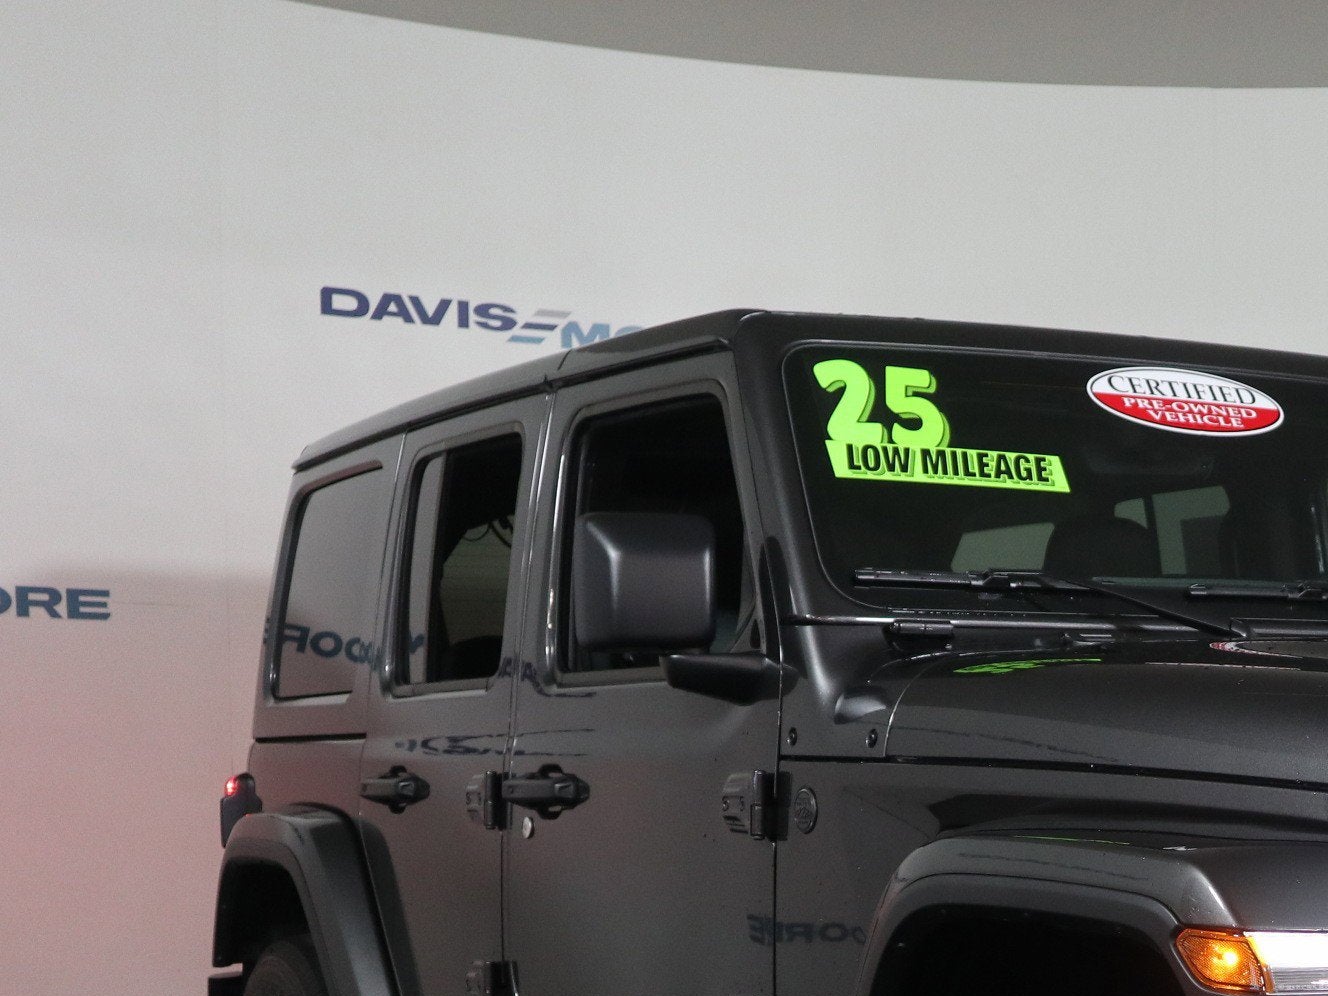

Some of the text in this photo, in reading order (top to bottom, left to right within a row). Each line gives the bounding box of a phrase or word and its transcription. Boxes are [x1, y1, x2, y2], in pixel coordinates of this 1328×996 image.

[319, 286, 518, 331] DAVIS
[812, 358, 951, 448] 25
[1106, 374, 1257, 406] CERTIFIED
[1121, 396, 1257, 419] PRE-OWNED
[1146, 409, 1245, 429] VEHICLE
[845, 442, 1053, 486] LOW MILEAGE
[0, 585, 111, 620] RE
